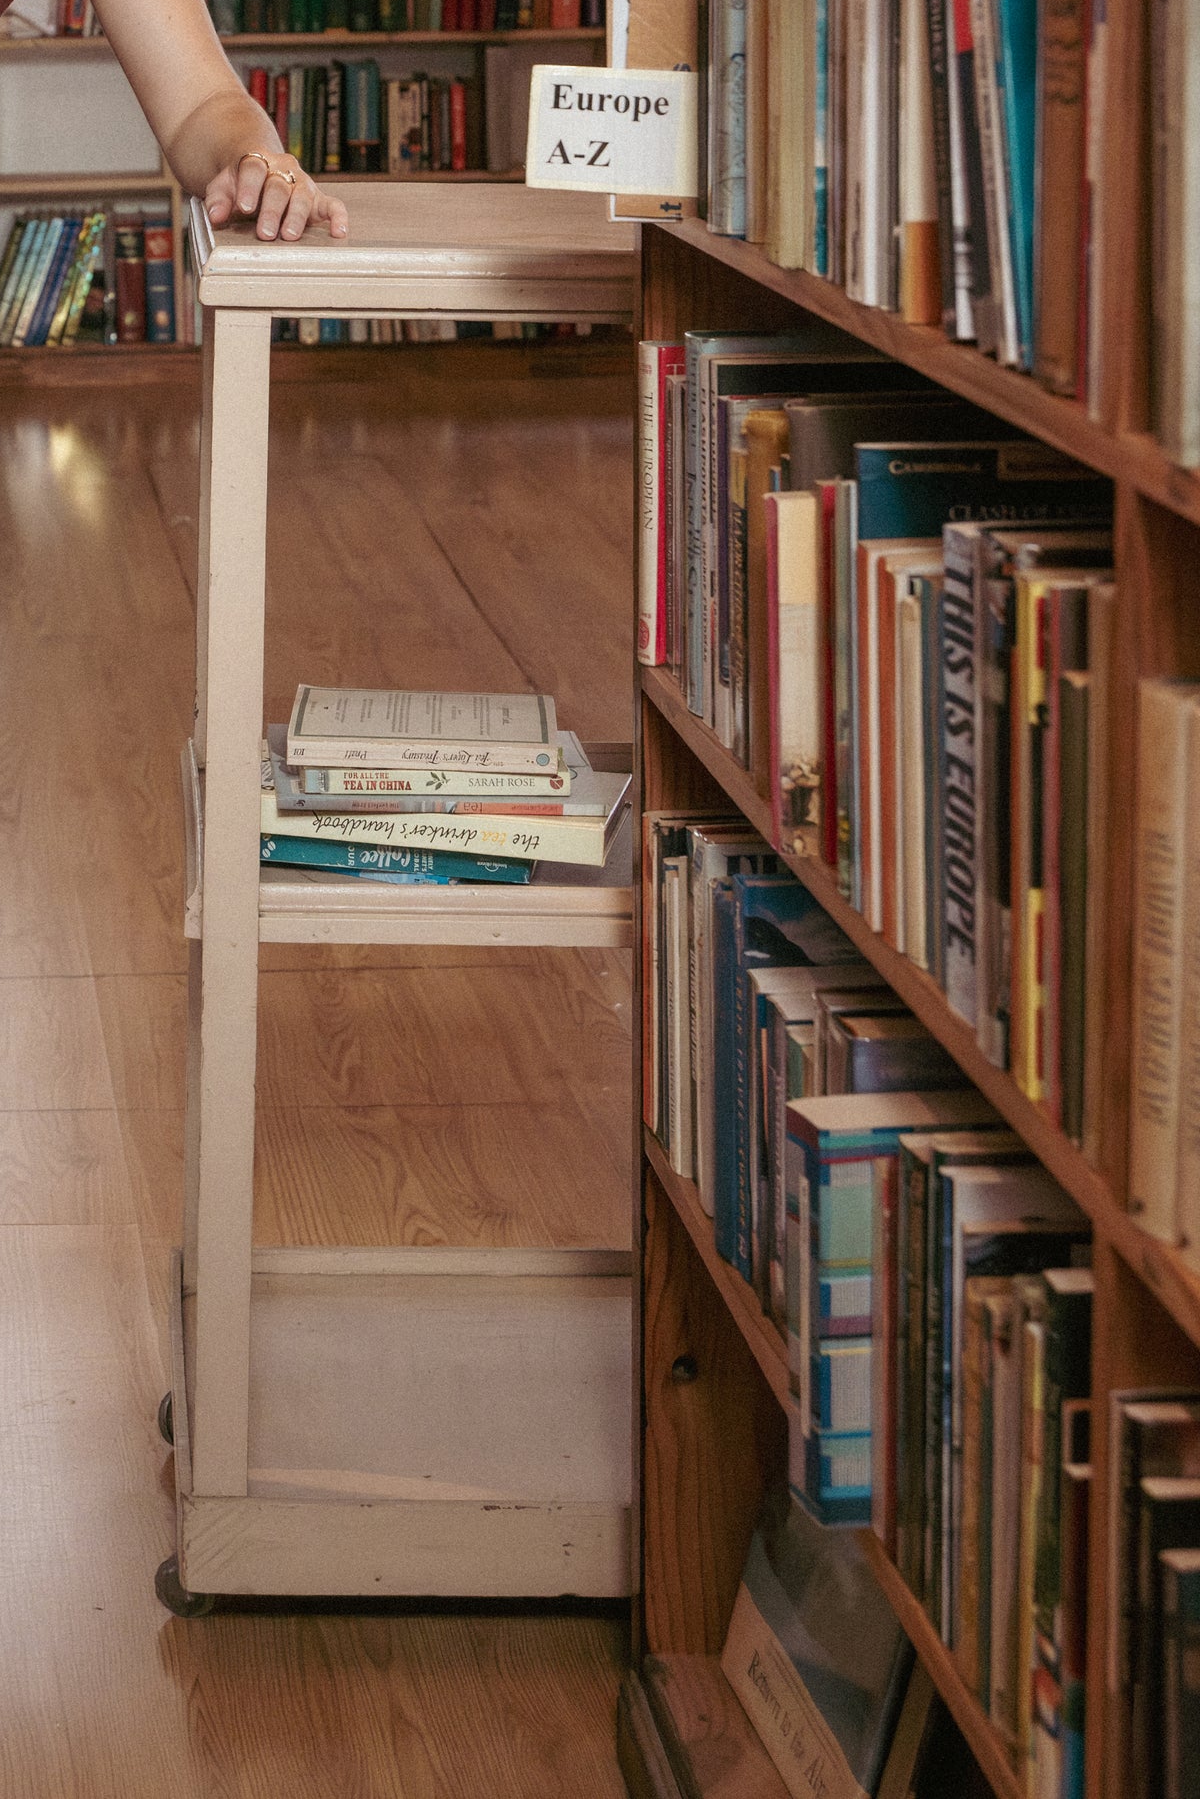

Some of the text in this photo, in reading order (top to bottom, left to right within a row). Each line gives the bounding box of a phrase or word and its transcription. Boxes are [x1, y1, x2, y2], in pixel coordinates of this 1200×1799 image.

[551, 83, 669, 122] Europe
[546, 139, 610, 167] A-Z
[643, 392, 654, 530] THE EUROPEAN
[402, 748, 440, 765] Treasury
[475, 752, 491, 767] Tea
[944, 565, 976, 966] THIS IS EUROPE
[343, 781, 412, 791] TEA IN CHINA
[468, 777, 536, 787] SARAH ROSE
[312, 810, 540, 852] the tea drinker's handbook
[347, 846, 355, 867] OUR
[360, 844, 411, 868] Coffee
